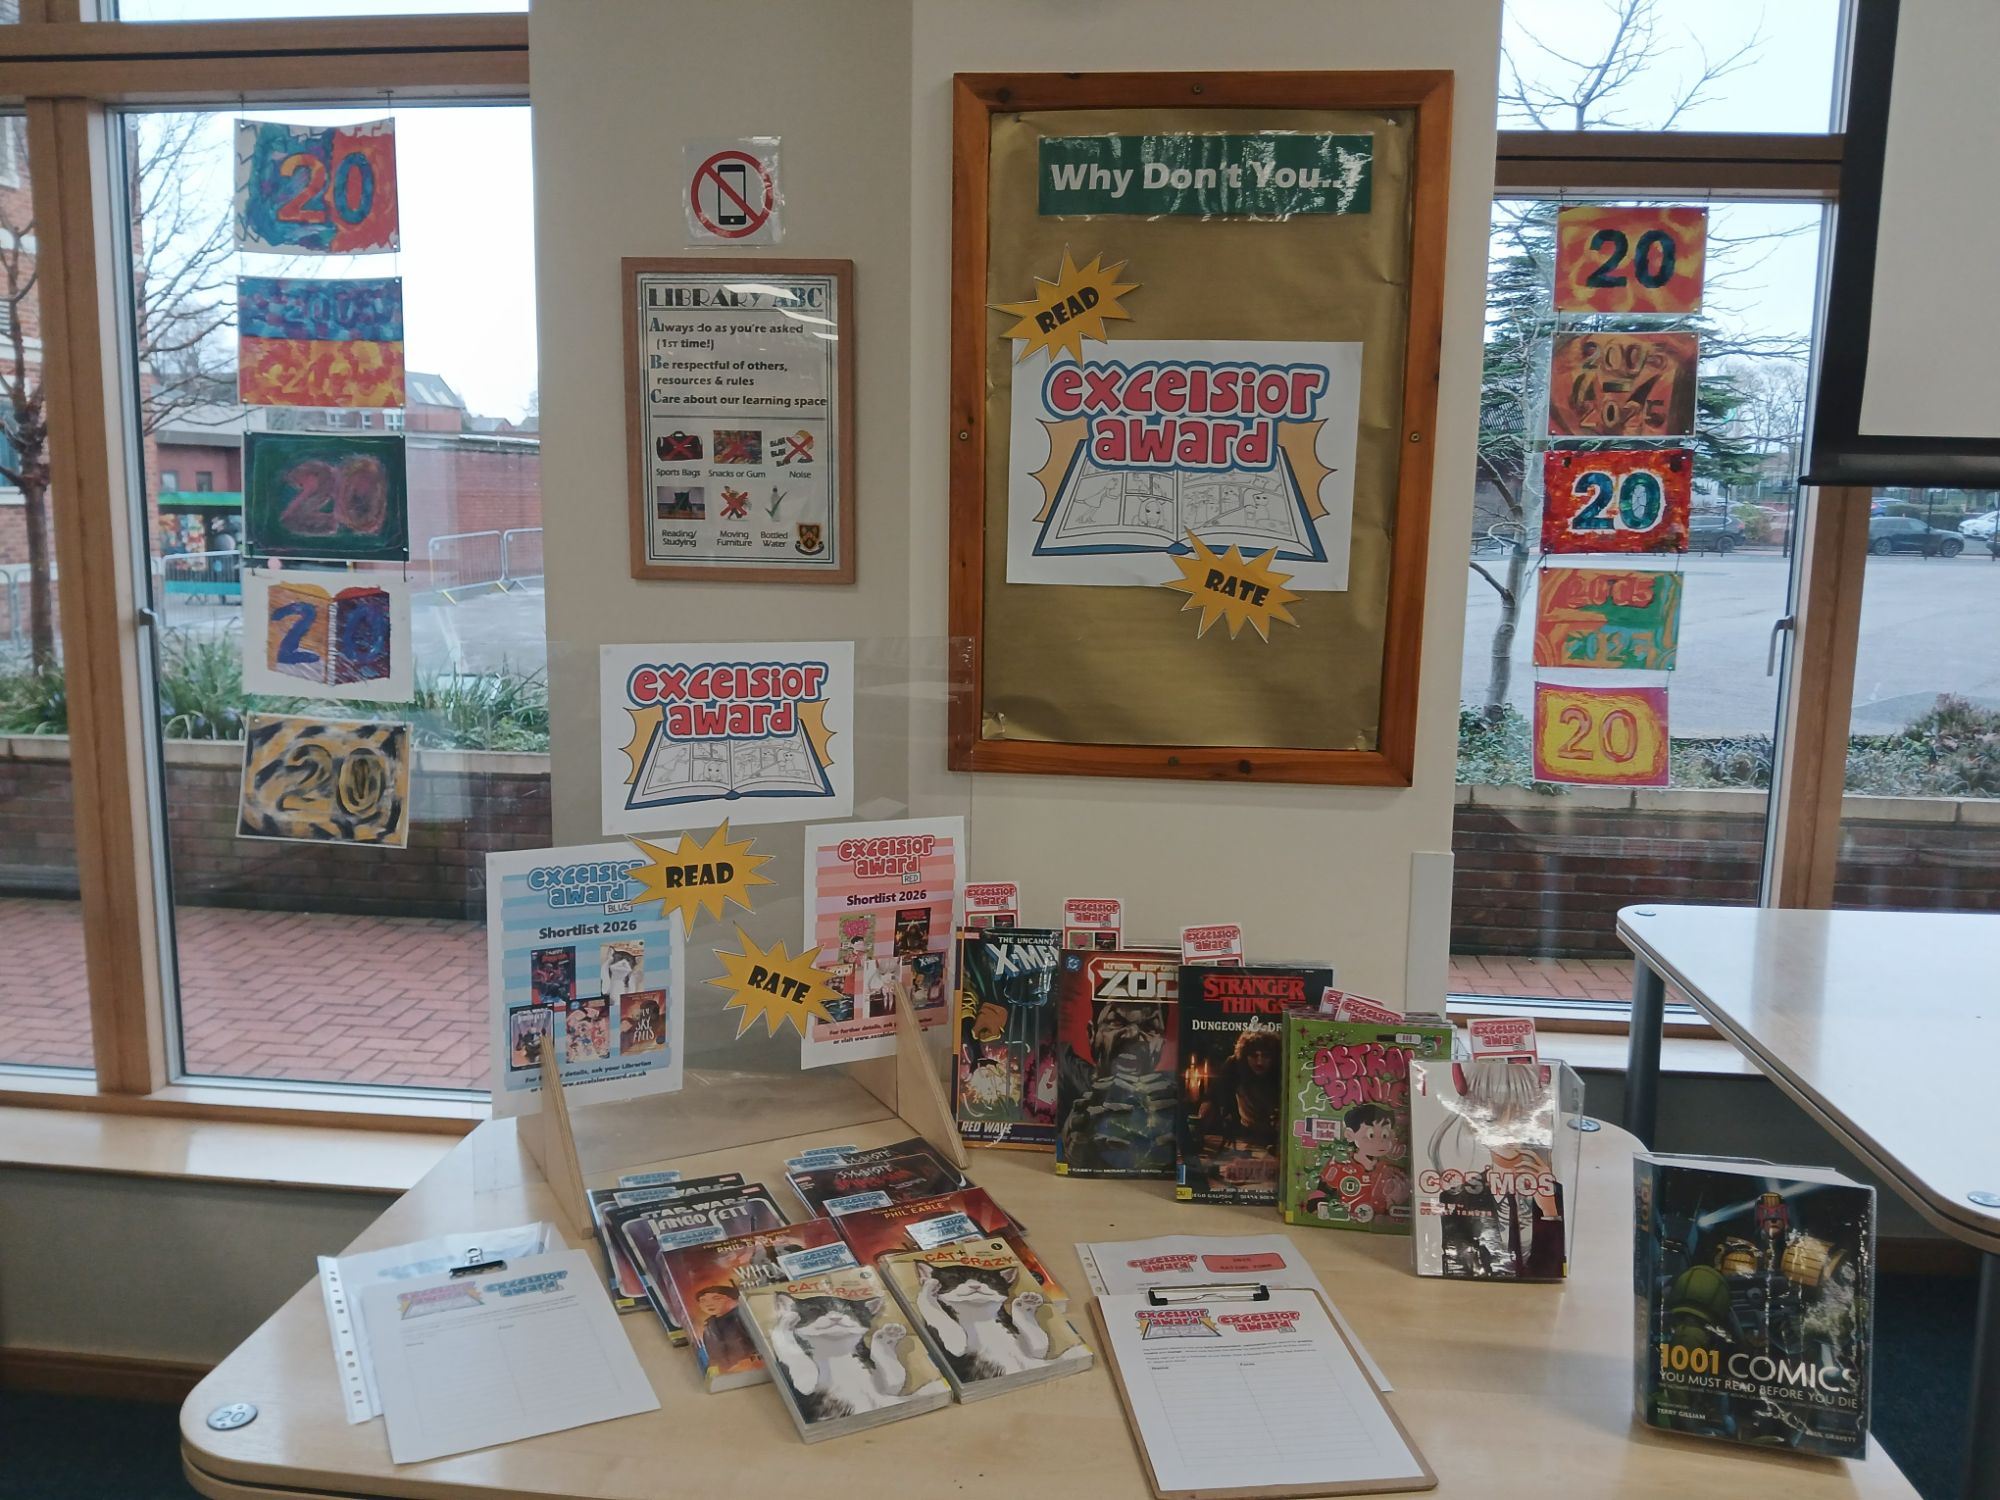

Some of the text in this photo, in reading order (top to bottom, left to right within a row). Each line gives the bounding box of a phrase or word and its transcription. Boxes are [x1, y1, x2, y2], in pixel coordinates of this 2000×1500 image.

[277, 152, 375, 225] 20
[1051, 163, 1133, 198] Why
[1143, 162, 1242, 190] Don't
[1586, 229, 1676, 289] 20
[648, 287, 760, 307] LIBRARY
[1035, 286, 1099, 334] READ
[649, 317, 804, 335] Always do as you're asked
[680, 338, 714, 350] time!)
[650, 355, 788, 374] Be respectful of others,
[657, 376, 754, 386] resources & rules
[650, 389, 827, 409] Care about our learning space
[1050, 368, 1321, 415] excelsior
[1095, 418, 1270, 465] award
[656, 468, 700, 478] Sports Bags
[708, 469, 734, 478] Snacks
[746, 470, 766, 478] Gum
[789, 470, 812, 478] Noise
[282, 454, 388, 534] 20
[1571, 470, 1662, 531] 20
[662, 538, 697, 547] Studying
[716, 538, 752, 547] Furniture
[720, 530, 749, 540] Moving
[760, 531, 788, 539] Bottled
[763, 539, 787, 548] Water
[1204, 568, 1270, 608] RATE
[271, 601, 385, 665] 20
[633, 667, 823, 702] excelsior
[668, 702, 793, 736] award
[1558, 706, 1638, 763] 20
[277, 744, 387, 816] 20
[840, 837, 933, 860] excelsior
[665, 862, 734, 888] READ
[856, 856, 919, 877] award
[904, 874, 919, 883] RED
[550, 883, 625, 906] award
[846, 890, 927, 907] Shortlist 2026
[539, 920, 637, 940] Shortlist 2026
[1017, 937, 1055, 945] UNCANNY
[986, 943, 1059, 975] X-MEN
[748, 965, 811, 1004] RATE
[1204, 976, 1306, 1002] STRANGER
[1221, 997, 1286, 1014] THINGS
[1192, 1019, 1248, 1031] DUNGEONS
[961, 1121, 1013, 1134] RED WAVE
[1419, 1168, 1557, 1196] COSMOS
[640, 1196, 749, 1219] STAR WARS
[884, 1210, 909, 1219] PHIL
[910, 1202, 945, 1214] EARLE
[925, 1252, 955, 1262] CAT
[960, 1256, 1013, 1267] CRAZY
[734, 1262, 784, 1280] WHEN
[787, 1282, 819, 1293] CAT
[1660, 1343, 1857, 1393] 1001 COMICS
[1660, 1370, 1858, 1409] YOU MUST READ BEFORE YOU DIE
